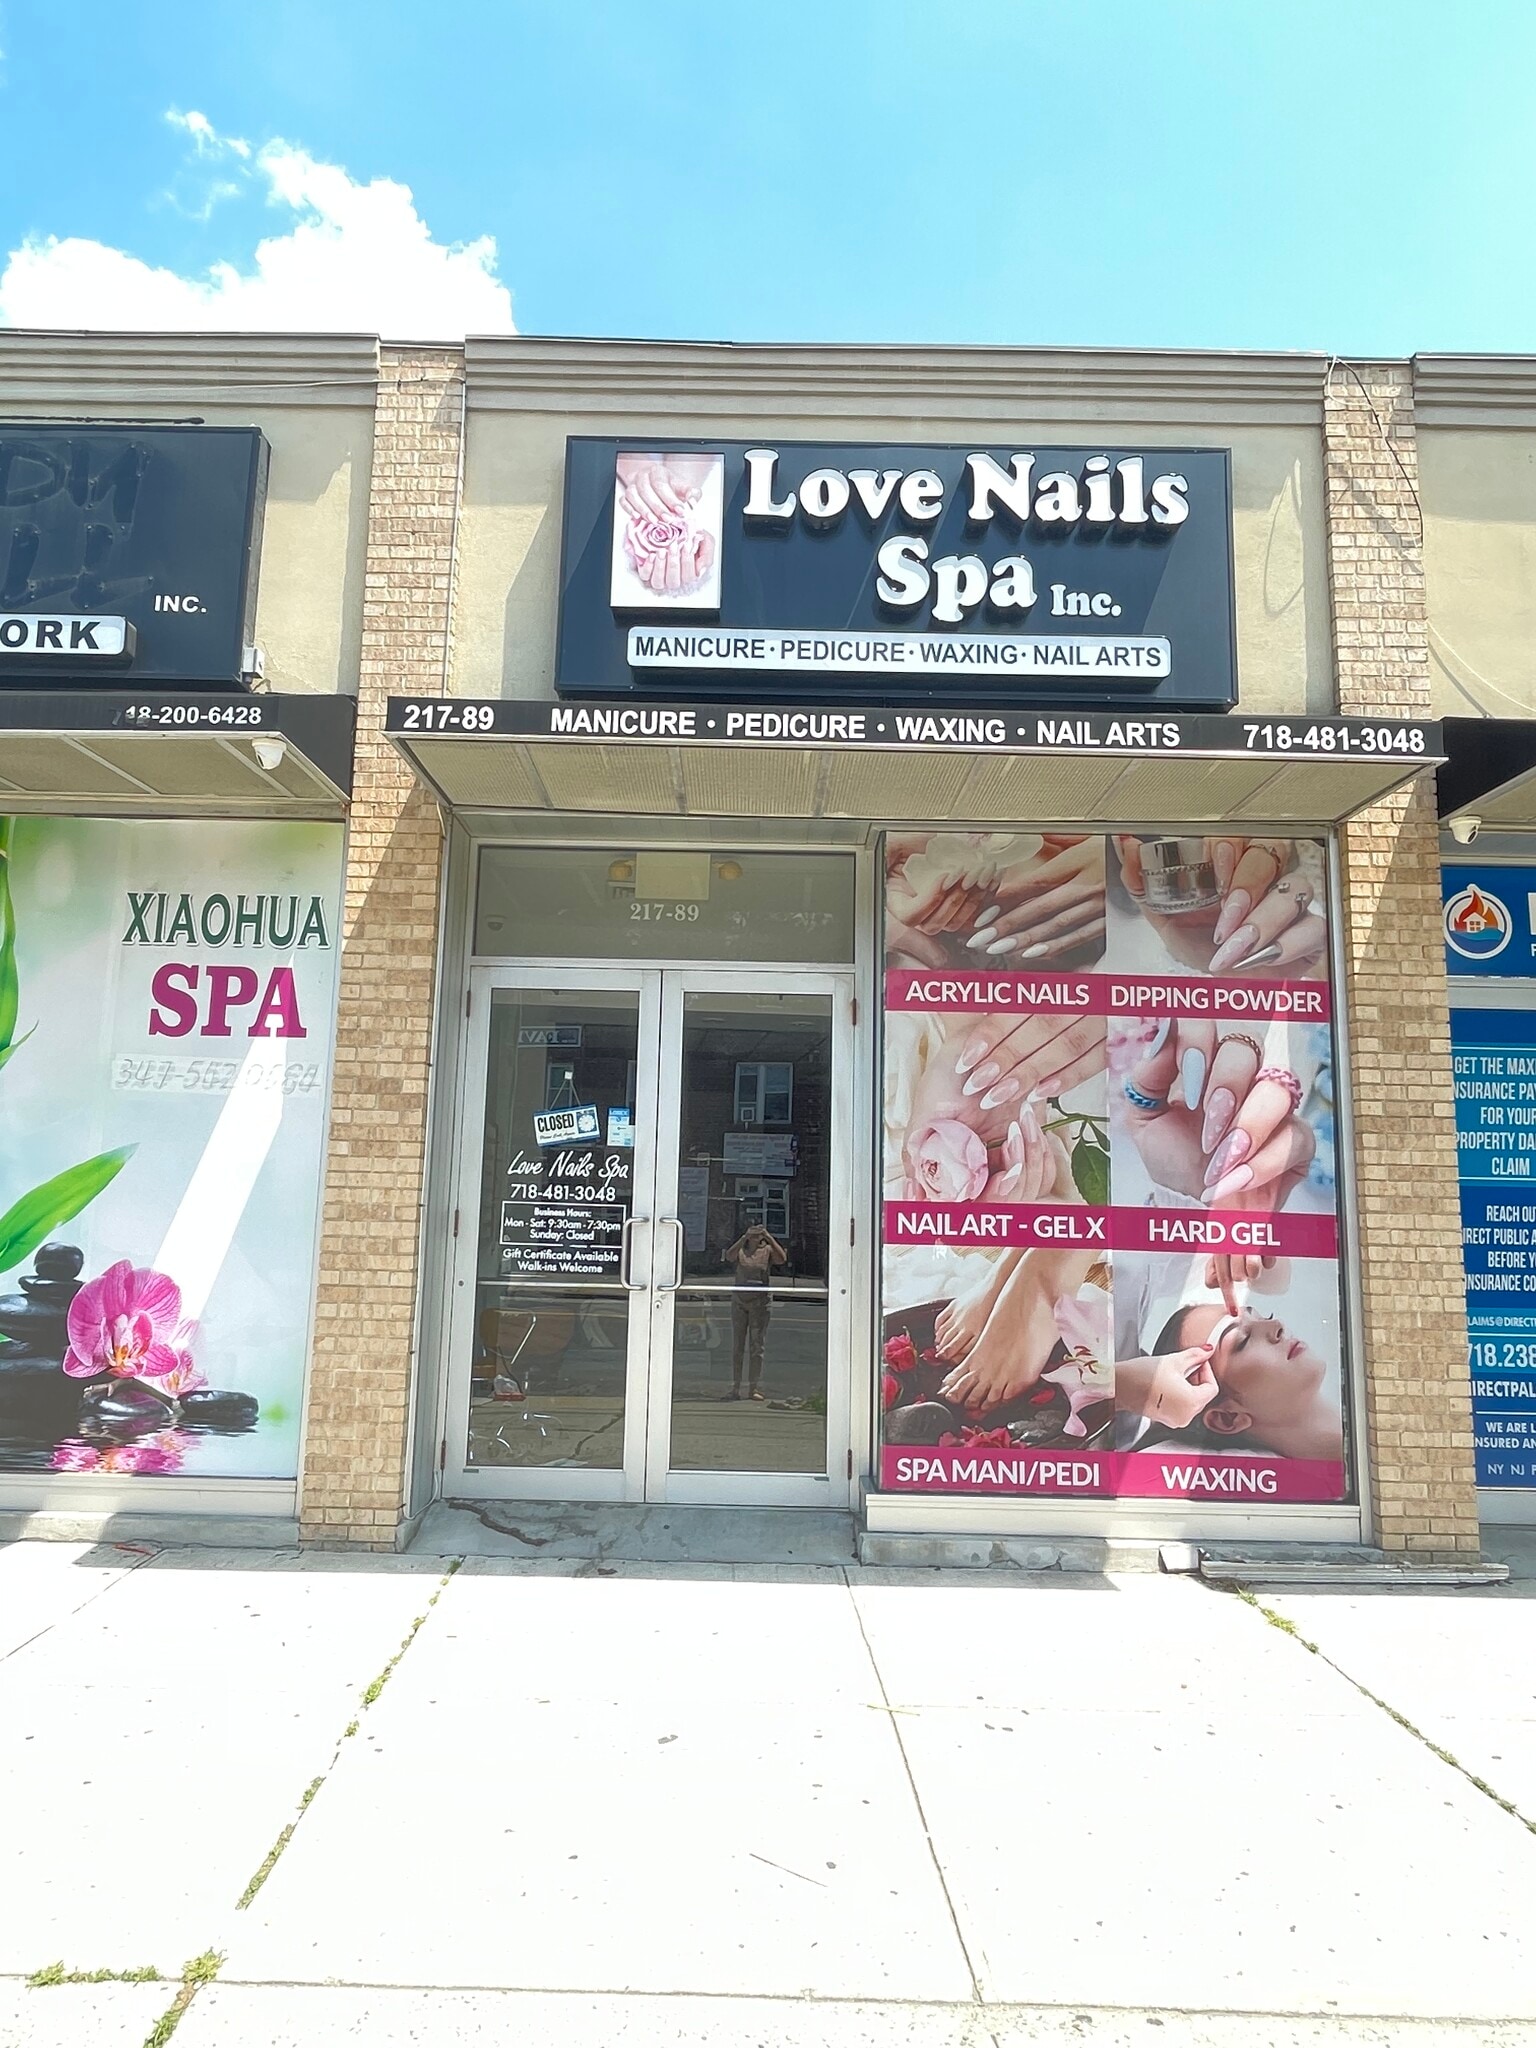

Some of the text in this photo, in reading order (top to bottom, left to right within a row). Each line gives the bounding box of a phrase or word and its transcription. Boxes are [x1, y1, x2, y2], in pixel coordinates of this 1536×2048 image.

[742, 448, 1190, 525] Love Nails
[876, 535, 1122, 621] Spa Inc.
[154, 595, 208, 613] INC.
[635, 636, 1162, 668] MANICURE PEDICURE WAXING NAIL ARTS
[403, 704, 495, 731] 217-89
[551, 708, 1181, 747] MANICURE PEDICURE WAXING NAIL ARTS
[1243, 724, 1425, 753] 718-481-3048
[122, 892, 331, 949] XIAOHUA
[629, 903, 700, 922] 217-89
[148, 962, 308, 1039] SPA
[905, 980, 1090, 1007] ACRYLIC NAILS
[1111, 985, 1323, 1013] DIPPING POWDER
[1454, 1056, 1477, 1074] GET
[1480, 1056, 1504, 1074] THE
[537, 1113, 575, 1132] CLOSED
[1480, 1106, 1504, 1125] FOR
[507, 1150, 629, 1187] Love Nails Spa
[1491, 1157, 1530, 1176] CLAIM
[510, 1184, 616, 1201] 718-481-3048
[534, 1207, 592, 1218] Business Hours:
[1486, 1205, 1520, 1222] REACH
[504, 1217, 524, 1228] Mon
[530, 1218, 547, 1229] Sat:
[548, 1219, 582, 1230] 9:30am
[587, 1220, 621, 1231] 7:30pm
[897, 1212, 959, 1236] NAIL
[960, 1213, 1013, 1237] ART
[1033, 1215, 1086, 1239] GEL
[1087, 1215, 1106, 1239] X
[1148, 1219, 1281, 1247] HARD GEL
[529, 1230, 595, 1241] Sunday: Closed
[1493, 1228, 1529, 1245] PUBLIC
[503, 1248, 619, 1262] Gift Certificate Available
[1487, 1250, 1527, 1268] BEFORE
[517, 1261, 603, 1273] Walk-ins Welcome
[1485, 1421, 1503, 1433] WE
[1506, 1422, 1527, 1433] ARE
[896, 1457, 1100, 1487] SPA MANI/PEDI
[1487, 1463, 1504, 1475] NY
[1510, 1464, 1525, 1475] NJ
[1161, 1465, 1278, 1493] WAXING
